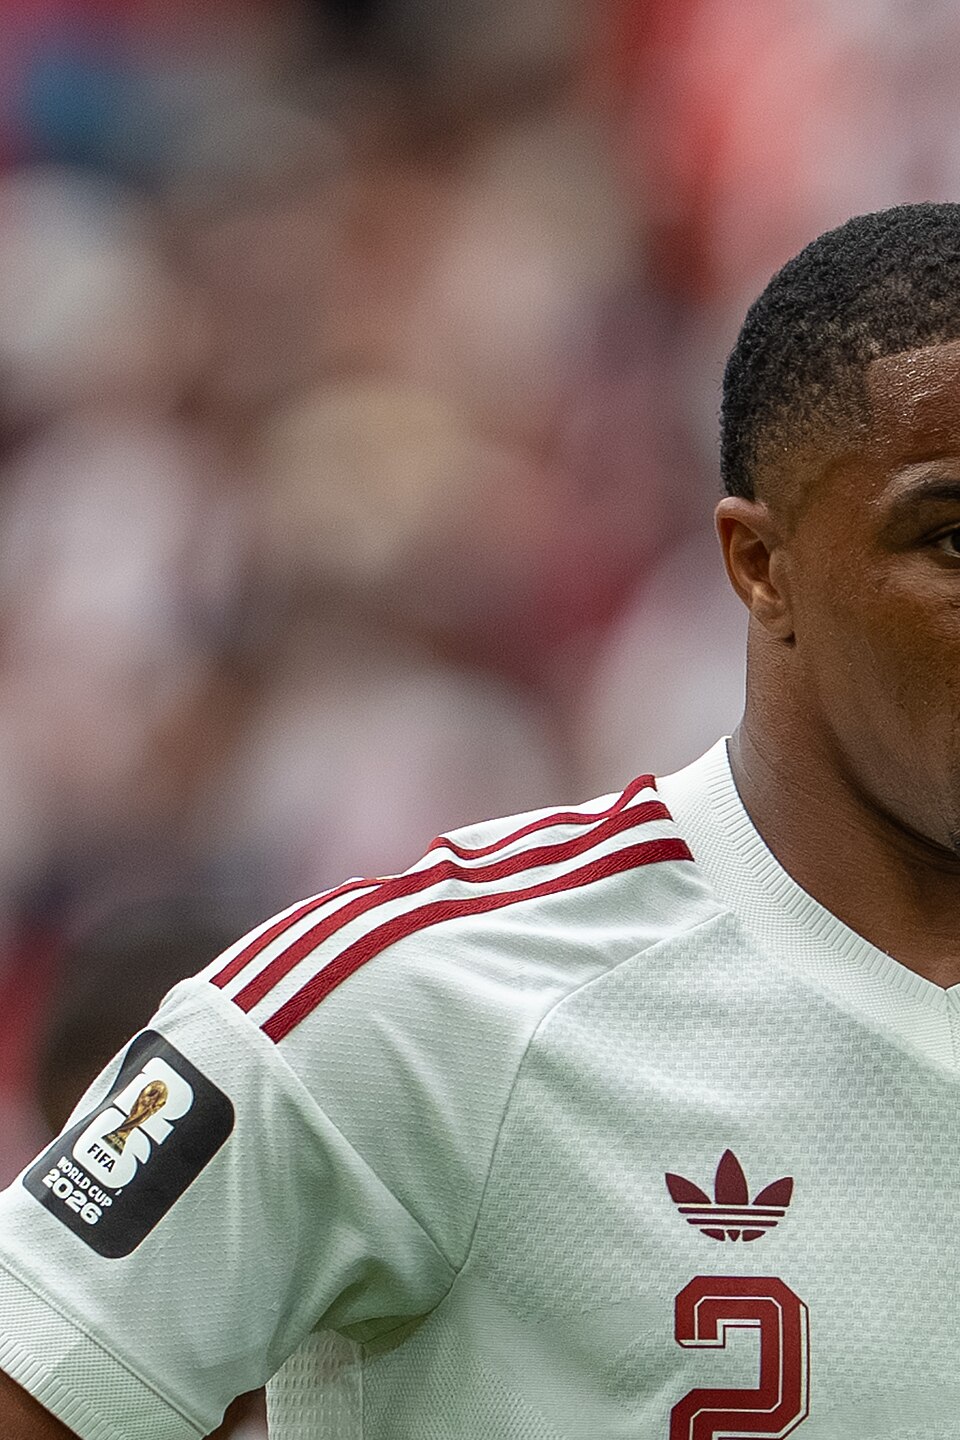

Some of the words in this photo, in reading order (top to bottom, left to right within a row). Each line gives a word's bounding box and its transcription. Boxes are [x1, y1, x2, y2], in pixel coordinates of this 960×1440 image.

[56, 1156, 91, 1190] WORLD
[87, 1184, 113, 1208] CUP
[87, 1143, 117, 1173] FIFA
[41, 1169, 103, 1225] 2026
